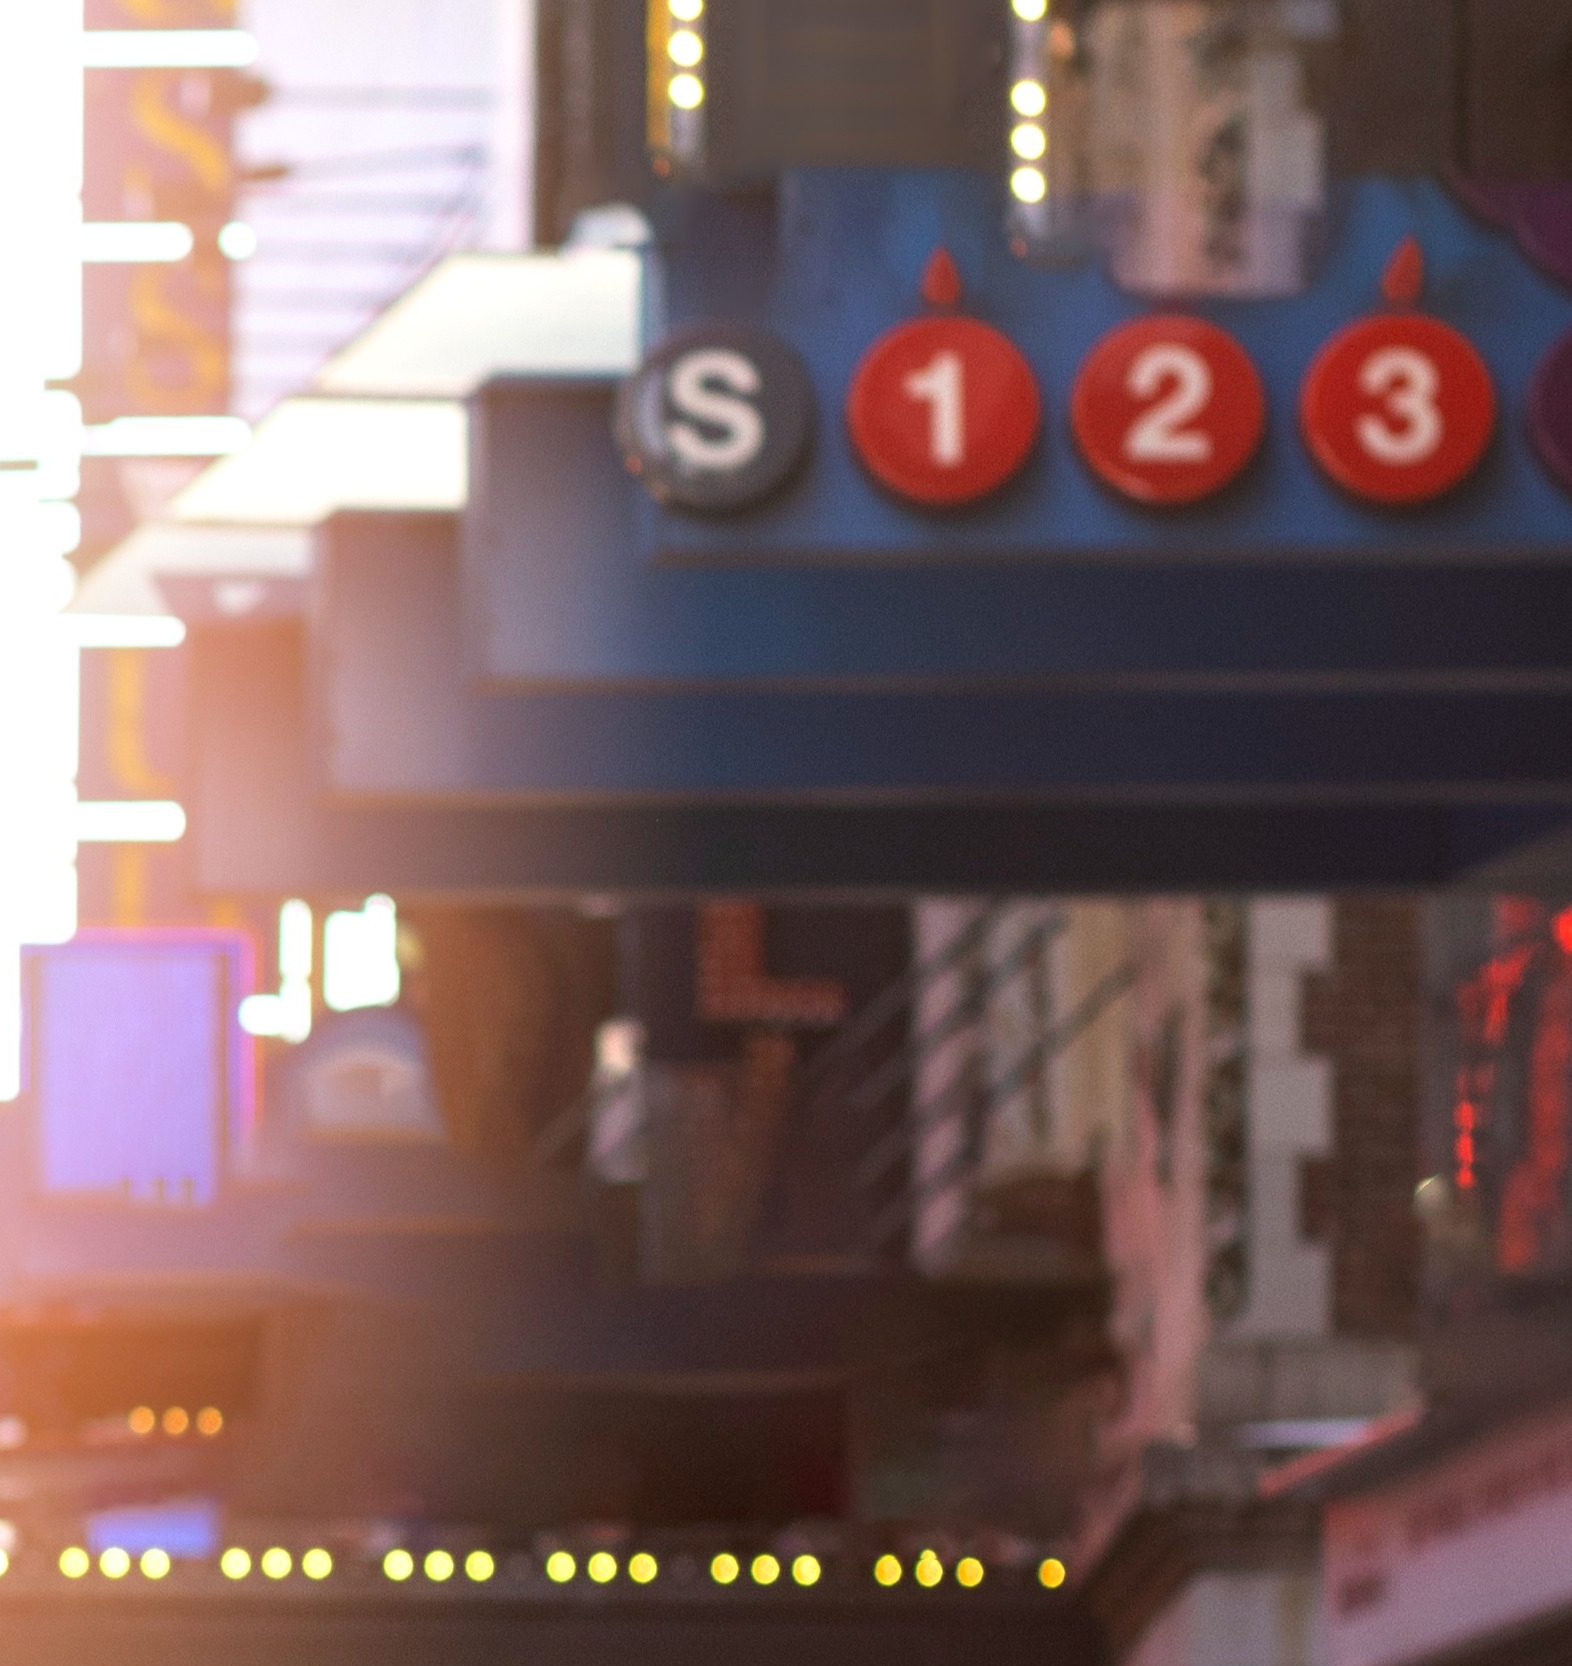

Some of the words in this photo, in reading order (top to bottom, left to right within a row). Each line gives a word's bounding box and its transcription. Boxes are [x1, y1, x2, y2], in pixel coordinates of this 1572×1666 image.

[665, 348, 767, 469] S
[901, 349, 966, 468] 1
[1123, 342, 1211, 462] 2
[1354, 344, 1445, 463] 3
